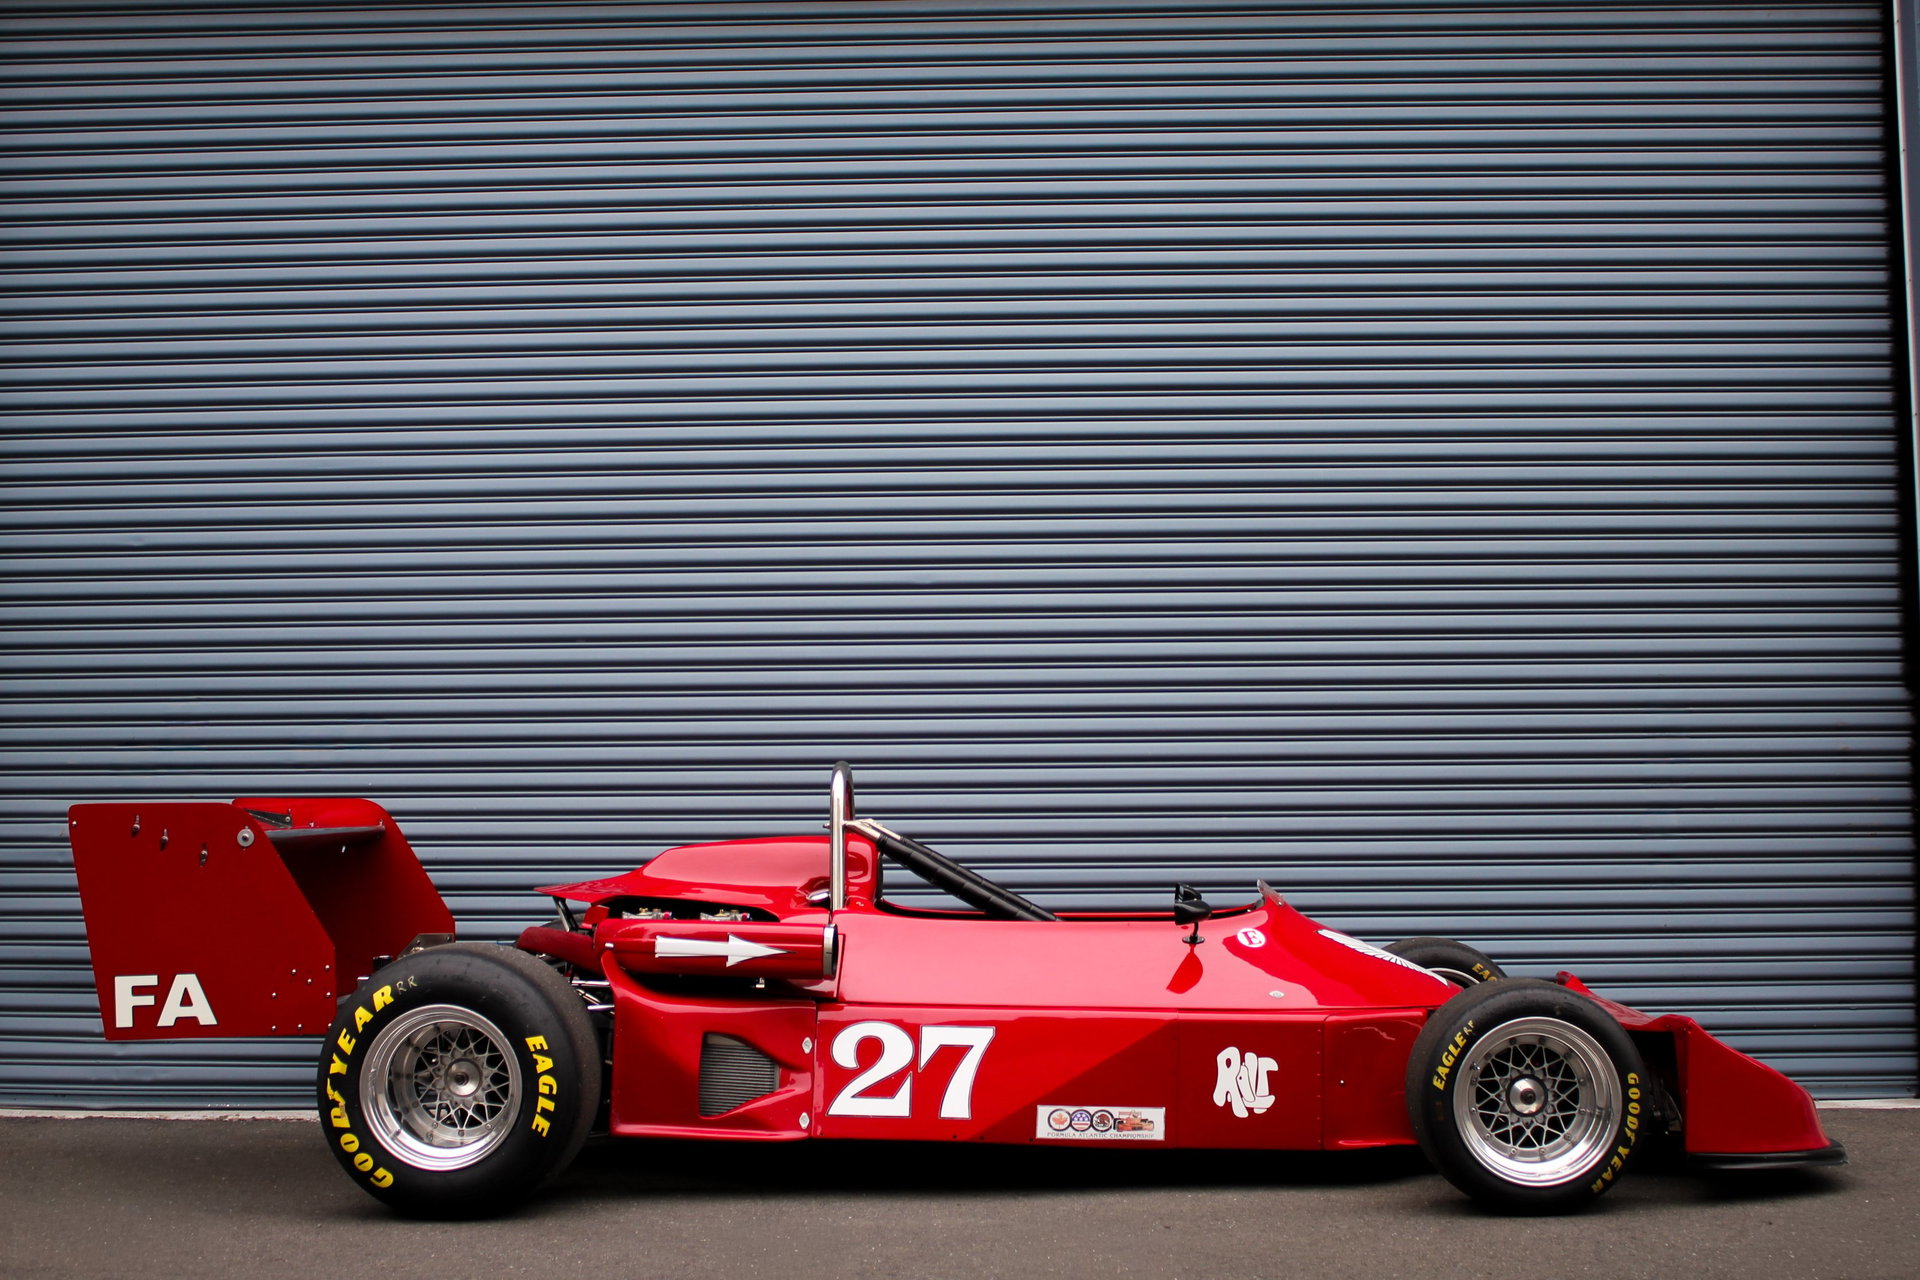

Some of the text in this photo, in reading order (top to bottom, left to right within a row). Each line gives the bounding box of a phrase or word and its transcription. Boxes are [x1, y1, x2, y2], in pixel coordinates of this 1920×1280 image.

[113, 973, 218, 1028] FA
[524, 1034, 558, 1138] EAGLE
[825, 1020, 996, 1120] 27
[1432, 1031, 1467, 1091] EAGLE
[1591, 1072, 1640, 1194] GOODYEAR
